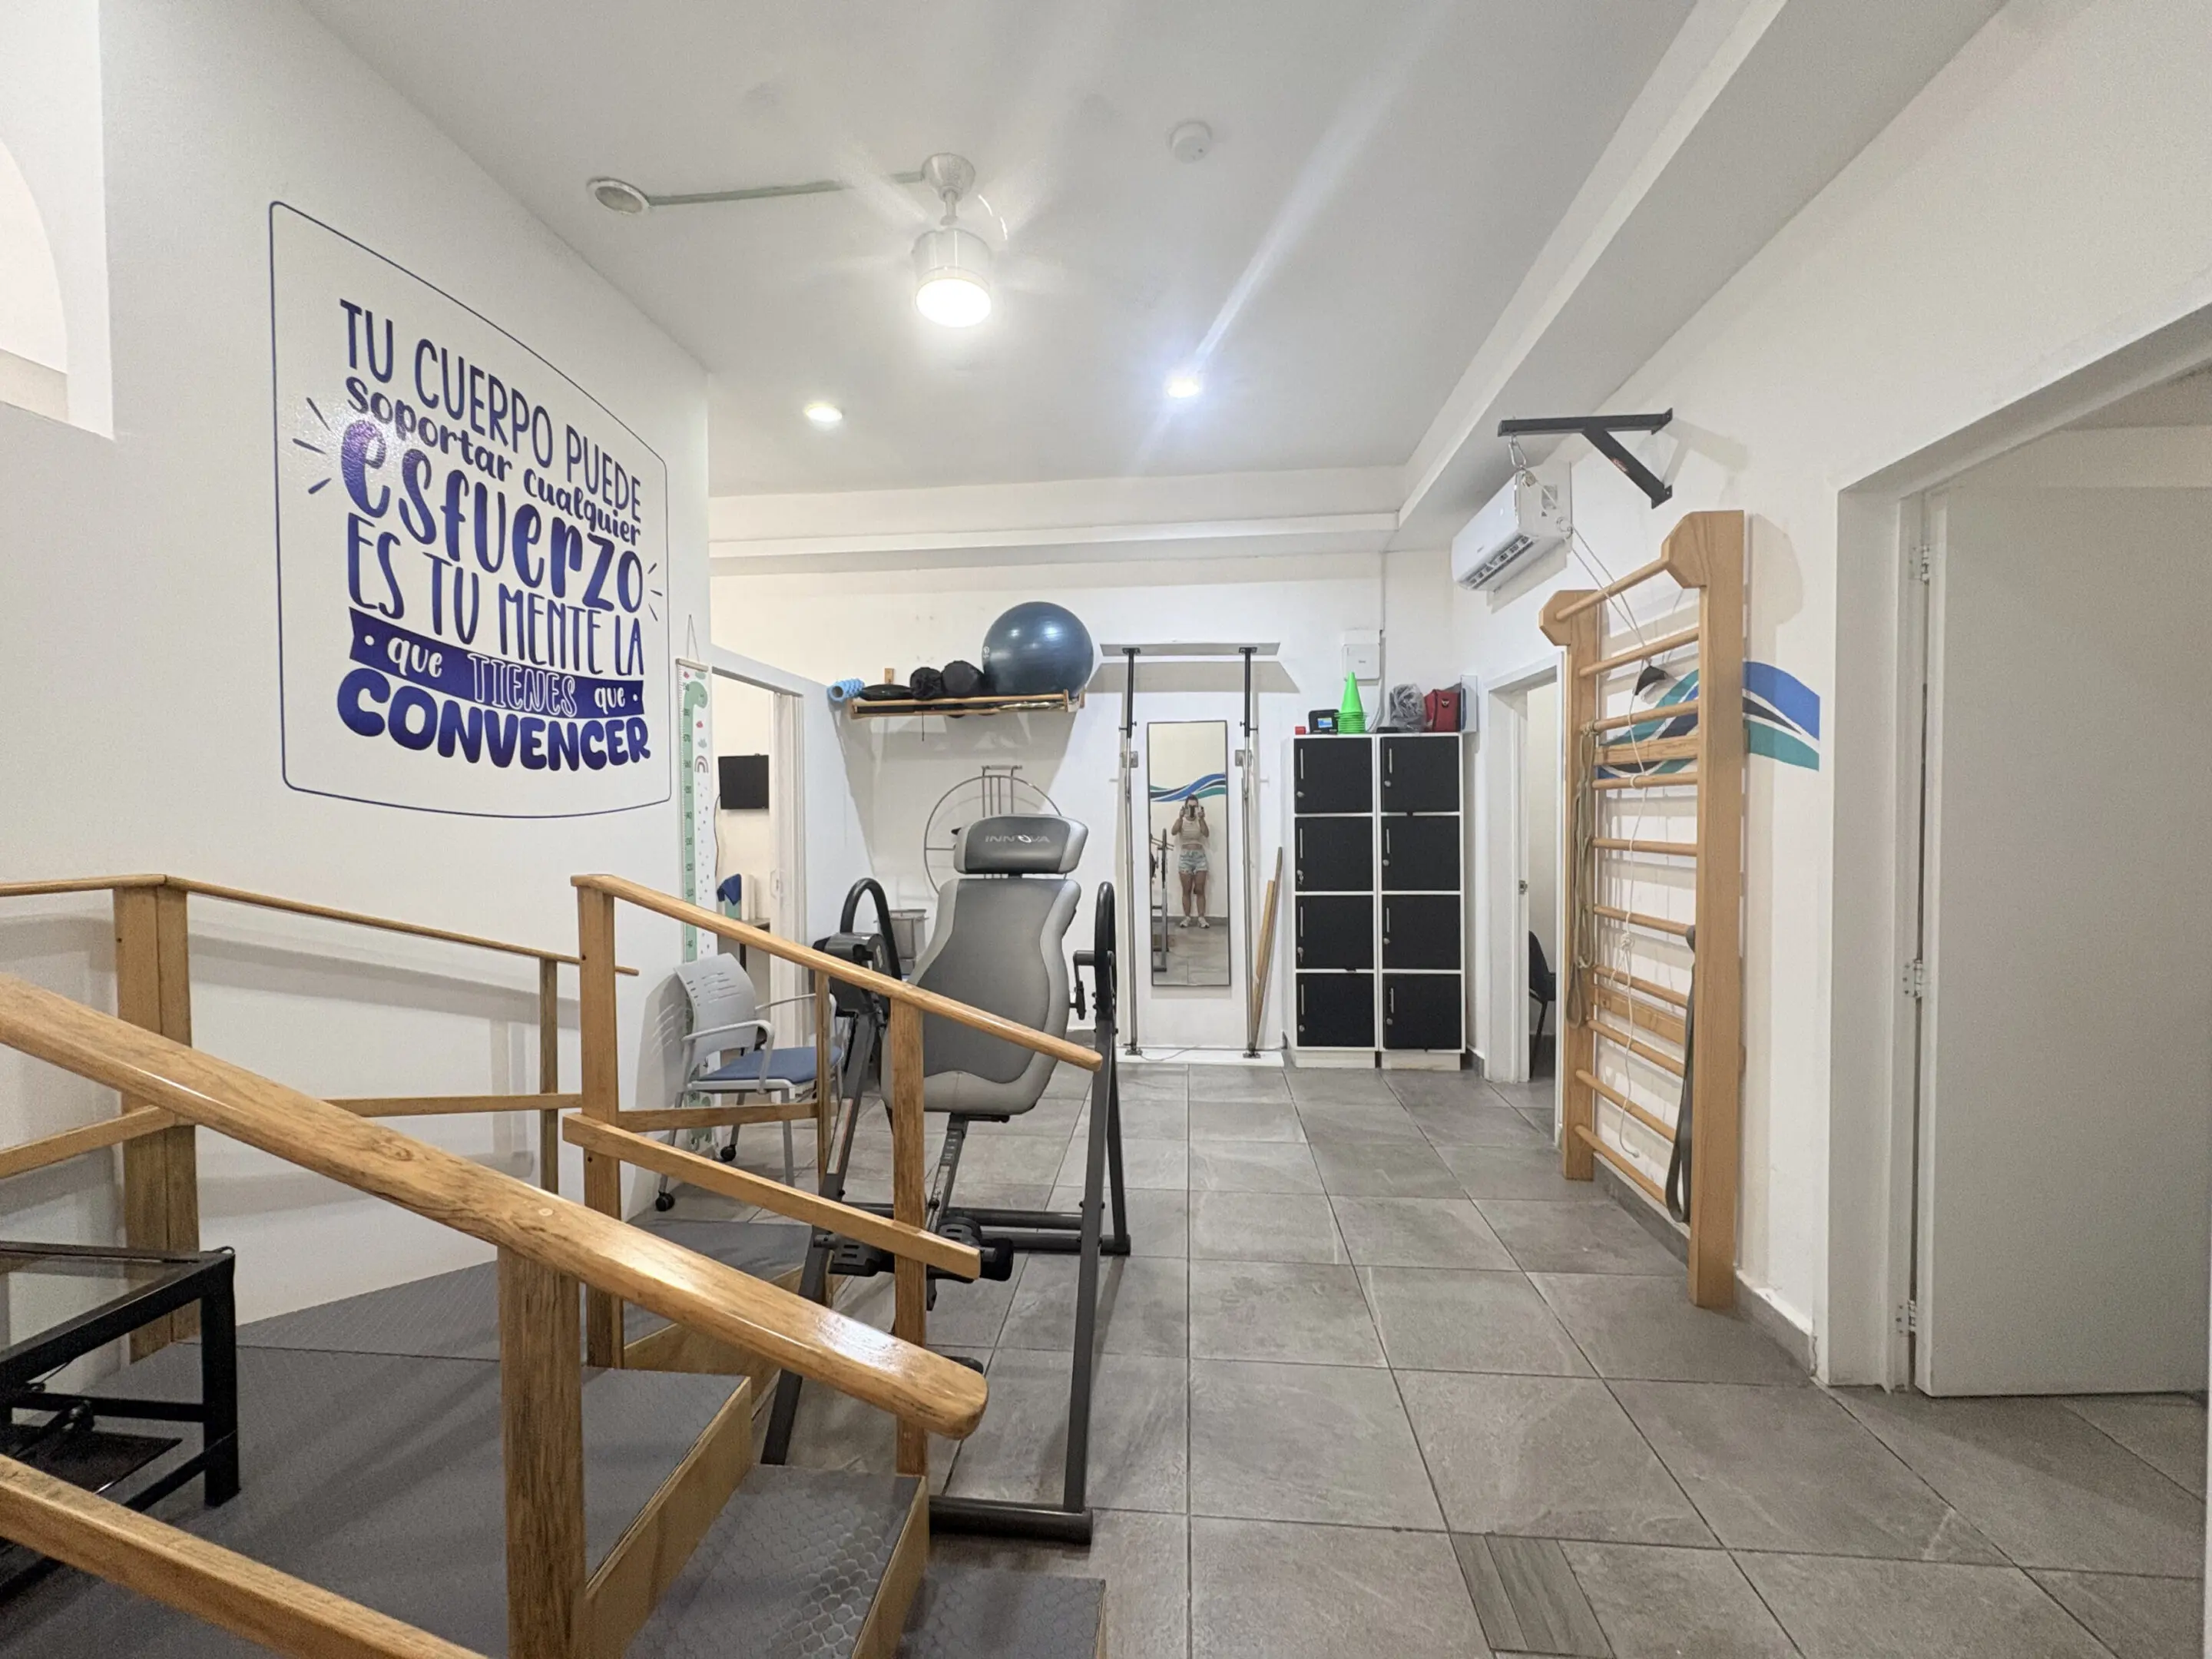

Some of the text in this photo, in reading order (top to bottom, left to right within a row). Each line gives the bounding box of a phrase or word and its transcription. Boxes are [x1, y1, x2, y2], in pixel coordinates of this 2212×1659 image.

[339, 298, 641, 524] TU CUERPO PUEDE
[345, 376, 641, 546] soportar cualquier
[347, 512, 644, 676] ES TU MENTE LA
[336, 667, 651, 771] CONVENCER
[387, 636, 626, 718] que TIENES que
